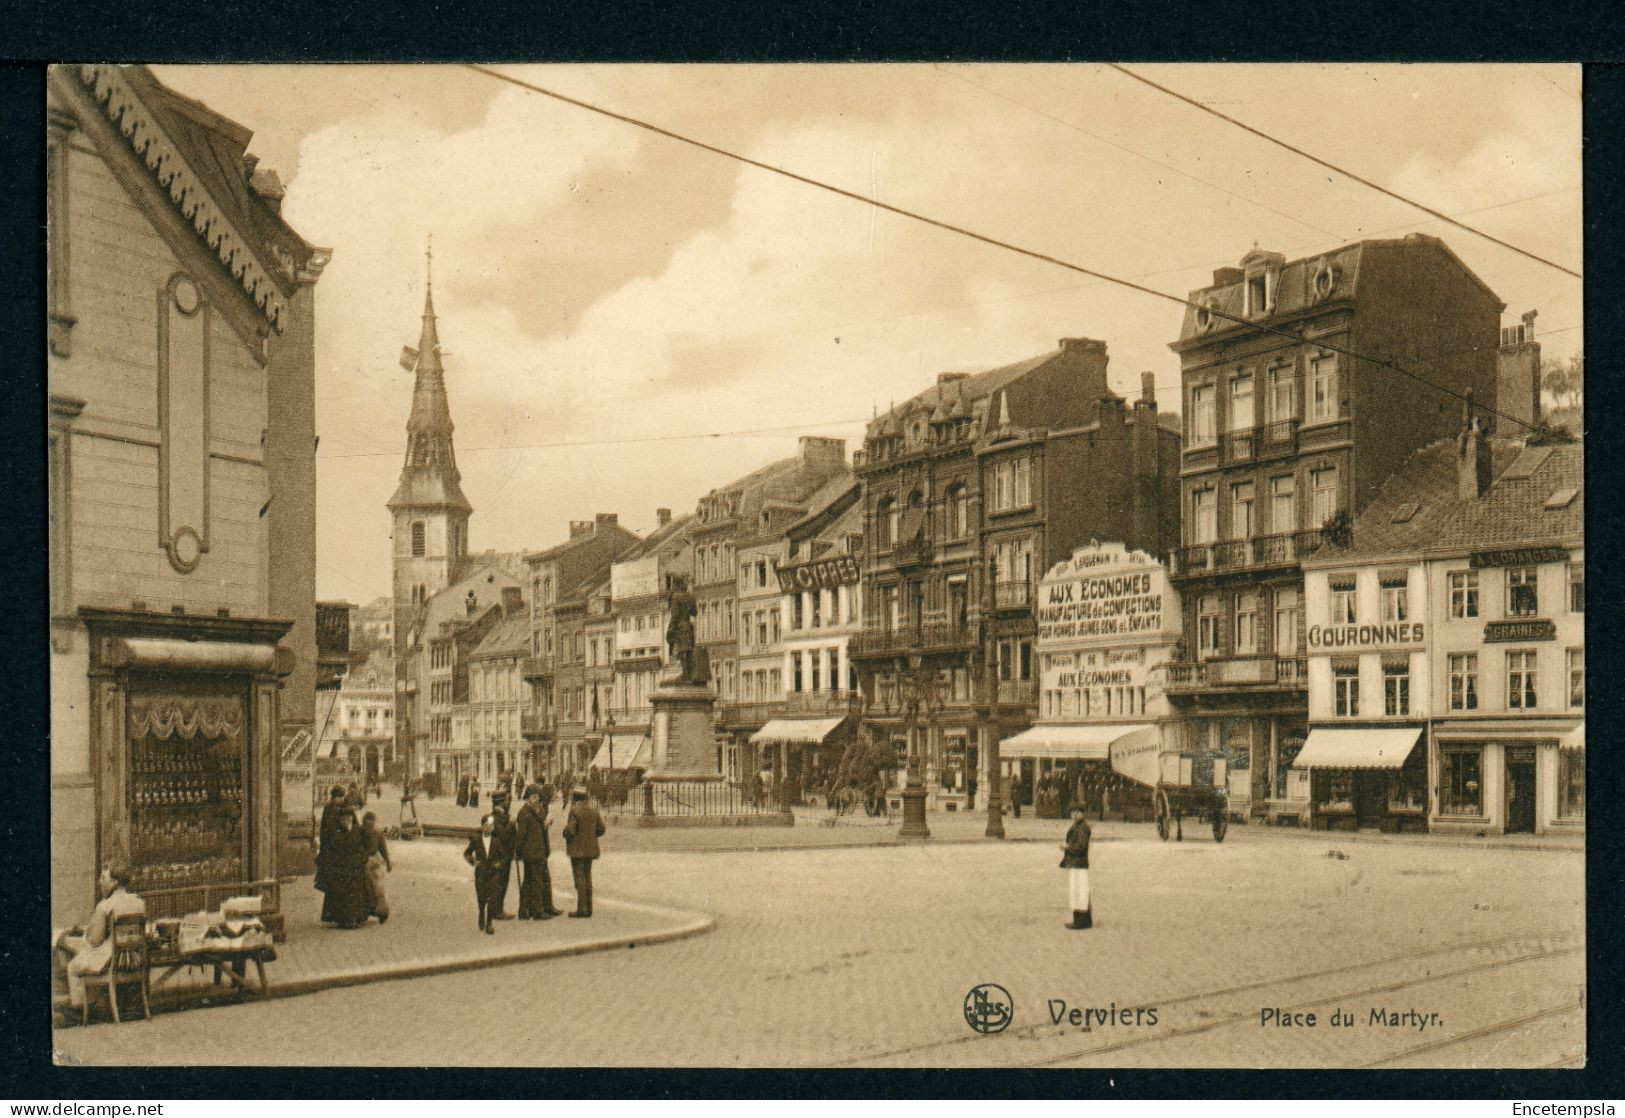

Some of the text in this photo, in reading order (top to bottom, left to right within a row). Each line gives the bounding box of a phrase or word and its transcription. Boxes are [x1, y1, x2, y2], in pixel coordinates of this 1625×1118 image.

[1049, 582, 1073, 605] AUX
[1039, 602, 1092, 623] MANUFACTURE
[1103, 594, 1162, 616] CONFECTIONS
[1128, 614, 1161, 632] ENFANTS
[1308, 622, 1425, 648] COURONNES
[1057, 671, 1077, 688] AUX
[1048, 999, 1159, 1027] Verviers
[1261, 1007, 1444, 1032] Place du Martyr.
